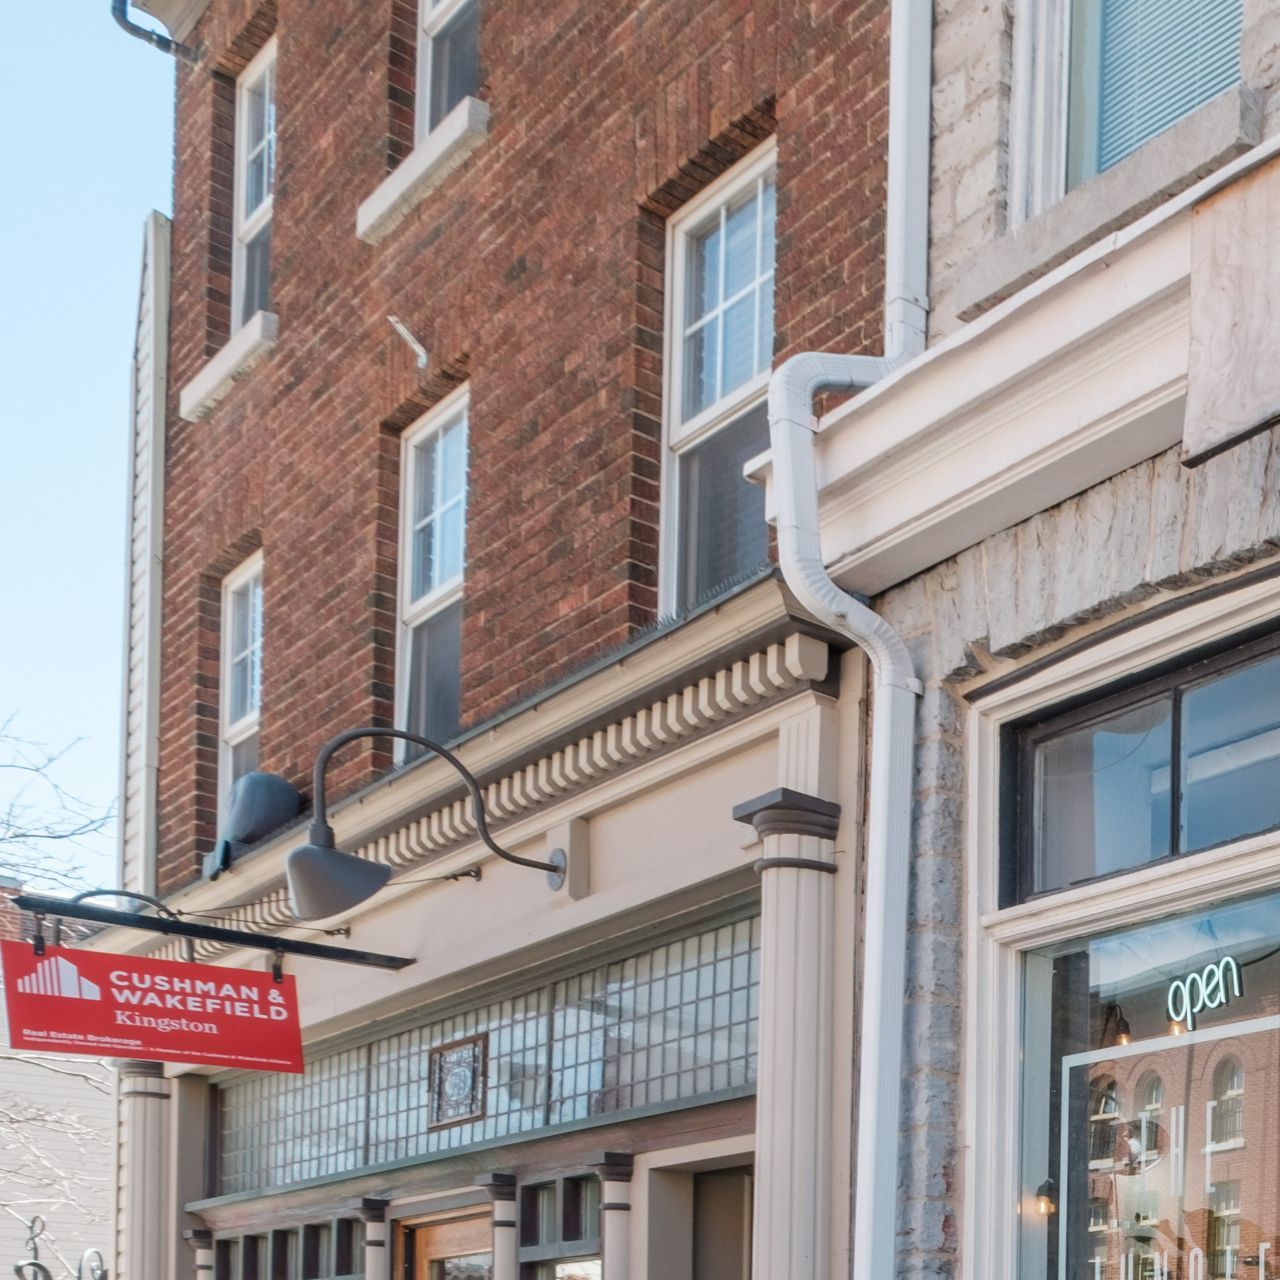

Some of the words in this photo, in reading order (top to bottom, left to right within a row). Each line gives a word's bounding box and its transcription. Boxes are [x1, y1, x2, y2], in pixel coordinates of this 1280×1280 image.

[109, 970, 260, 1001] CUSHMAN
[267, 989, 286, 1004] &
[1168, 956, 1240, 1031] open
[110, 988, 288, 1021] WAKEFIELD
[114, 1010, 219, 1034] Kingston
[1138, 1100, 1217, 1196] THE
